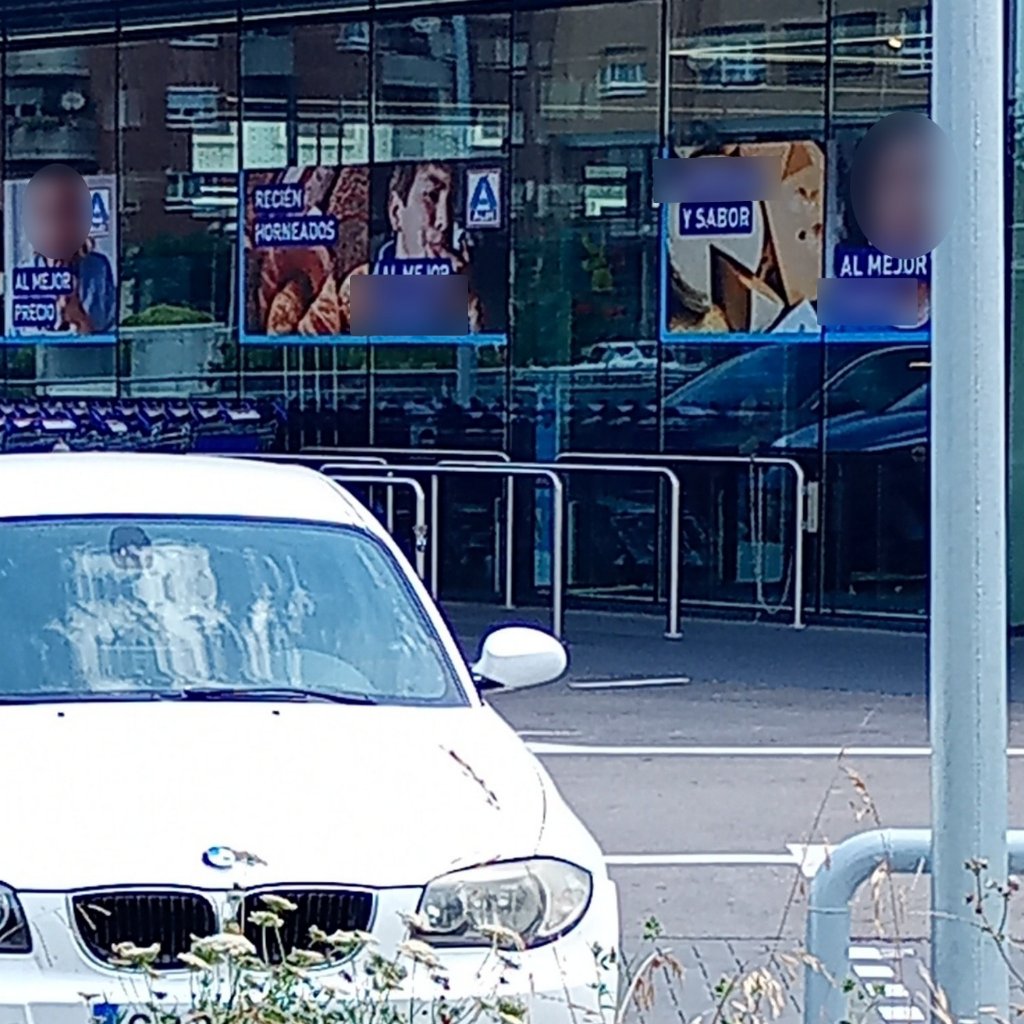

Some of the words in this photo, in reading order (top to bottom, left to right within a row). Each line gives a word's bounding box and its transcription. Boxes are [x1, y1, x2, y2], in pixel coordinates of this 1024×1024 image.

[254, 186, 302, 209] RECIÉN
[682, 208, 694, 230] Y
[695, 206, 751, 229] SABOR
[255, 220, 336, 243] HORNEADOS
[839, 254, 864, 277] AL
[867, 253, 928, 276] MEJOR
[14, 273, 30, 291] AL
[31, 271, 72, 291] MEJOR
[14, 303, 55, 322] PRECIO
